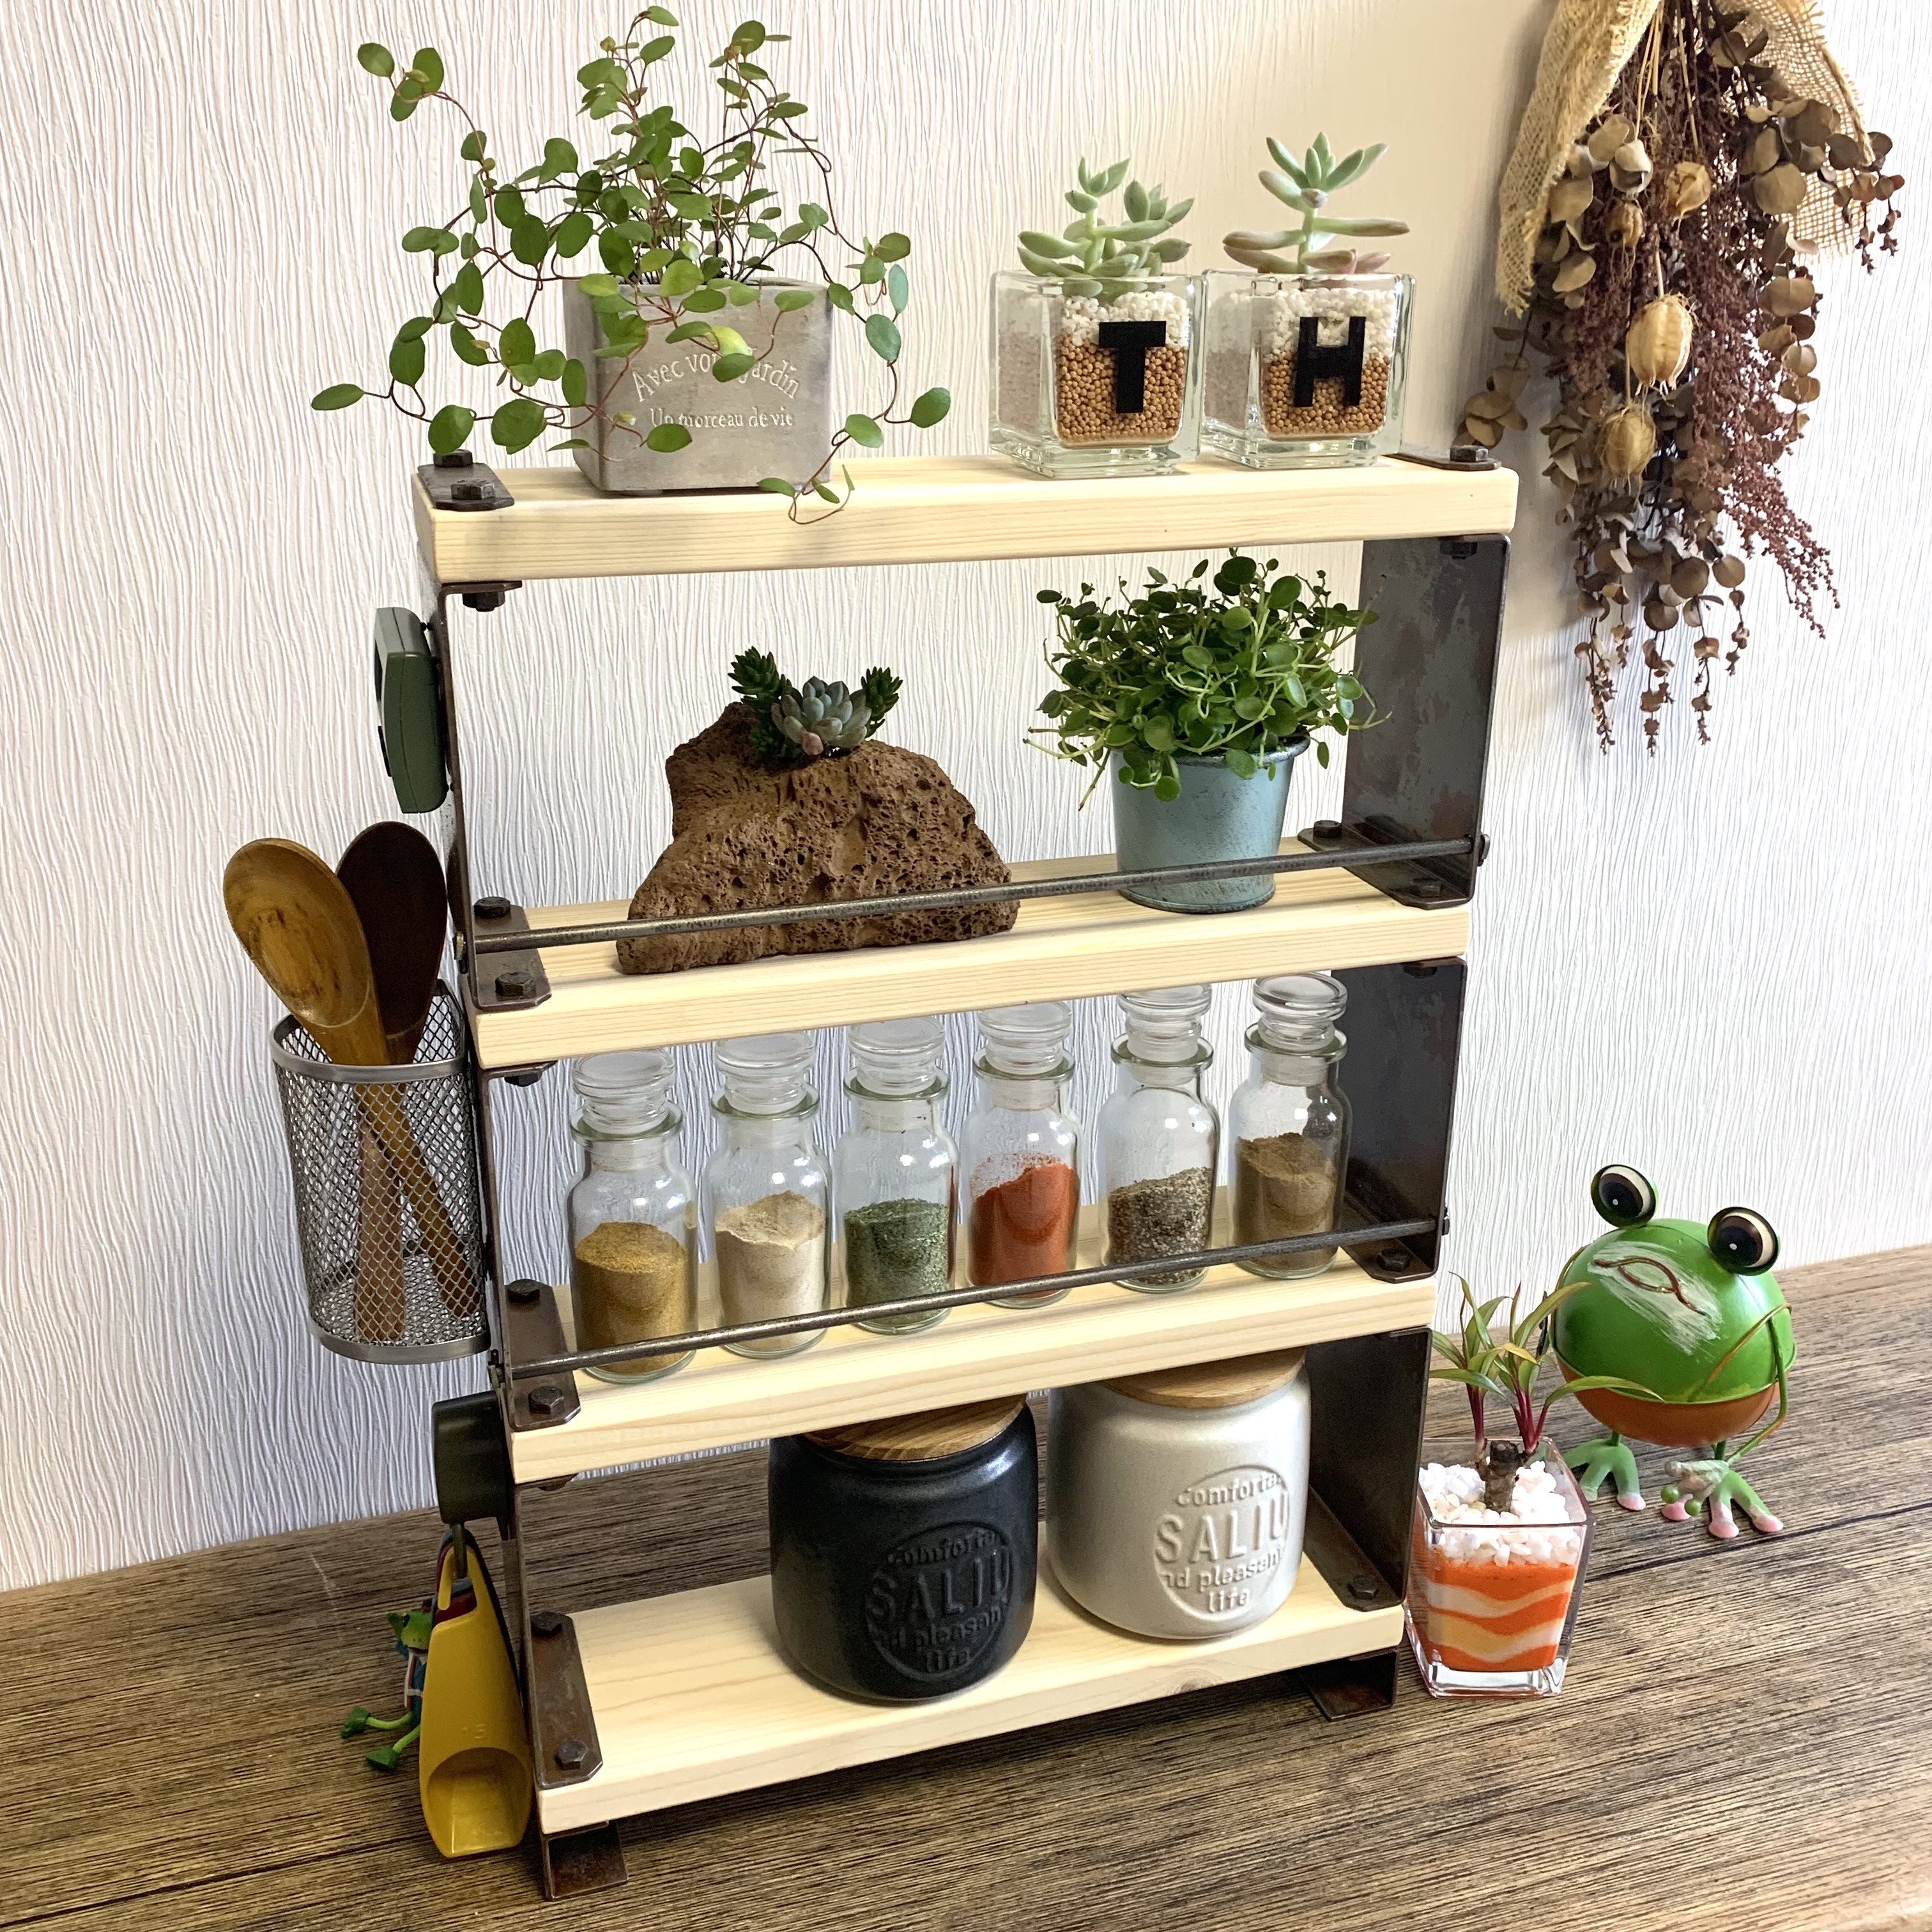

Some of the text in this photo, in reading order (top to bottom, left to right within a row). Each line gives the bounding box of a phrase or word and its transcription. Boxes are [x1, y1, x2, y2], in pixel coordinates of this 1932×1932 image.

[632, 361, 685, 402] Avec
[1099, 321, 1167, 413] T
[1294, 316, 1367, 408] H
[650, 406, 794, 427] Un morceau de vie
[1208, 1587, 1250, 1613] life
